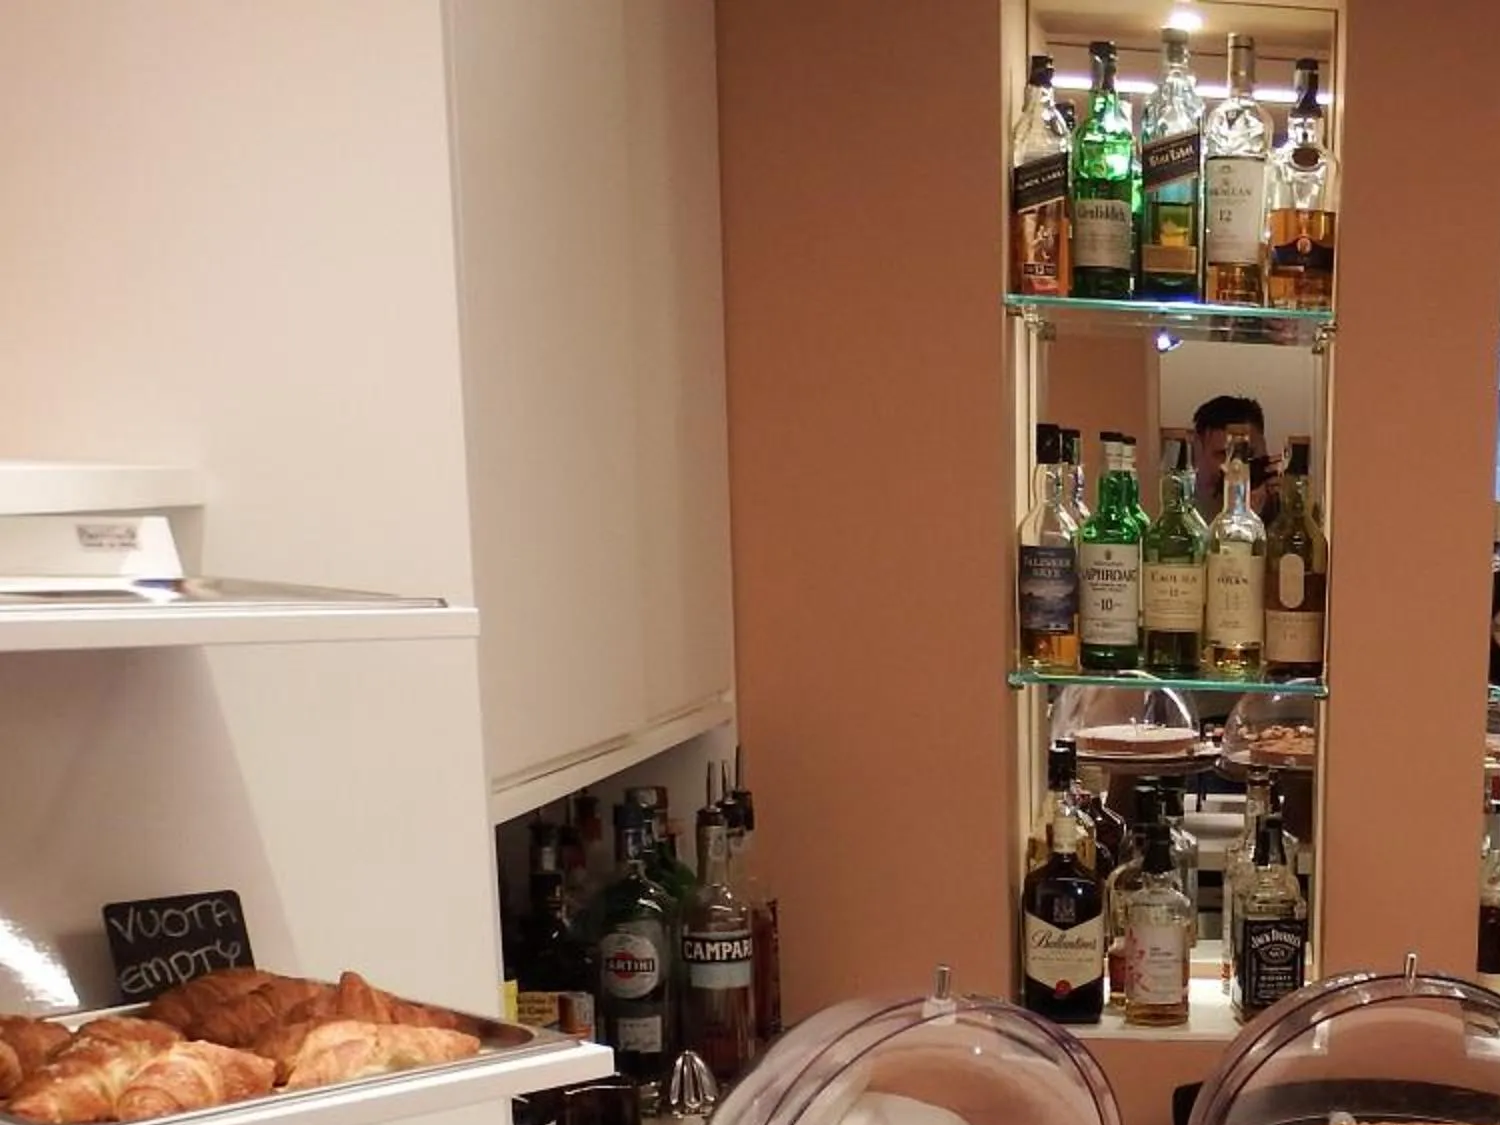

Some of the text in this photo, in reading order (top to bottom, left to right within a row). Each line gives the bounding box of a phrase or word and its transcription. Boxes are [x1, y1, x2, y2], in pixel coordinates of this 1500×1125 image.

[1101, 598, 1114, 612] 10
[110, 899, 238, 943] VUOTA
[684, 940, 753, 961] CAMPAR
[121, 939, 241, 993] EMPTY
[604, 959, 653, 972] ARTINI
